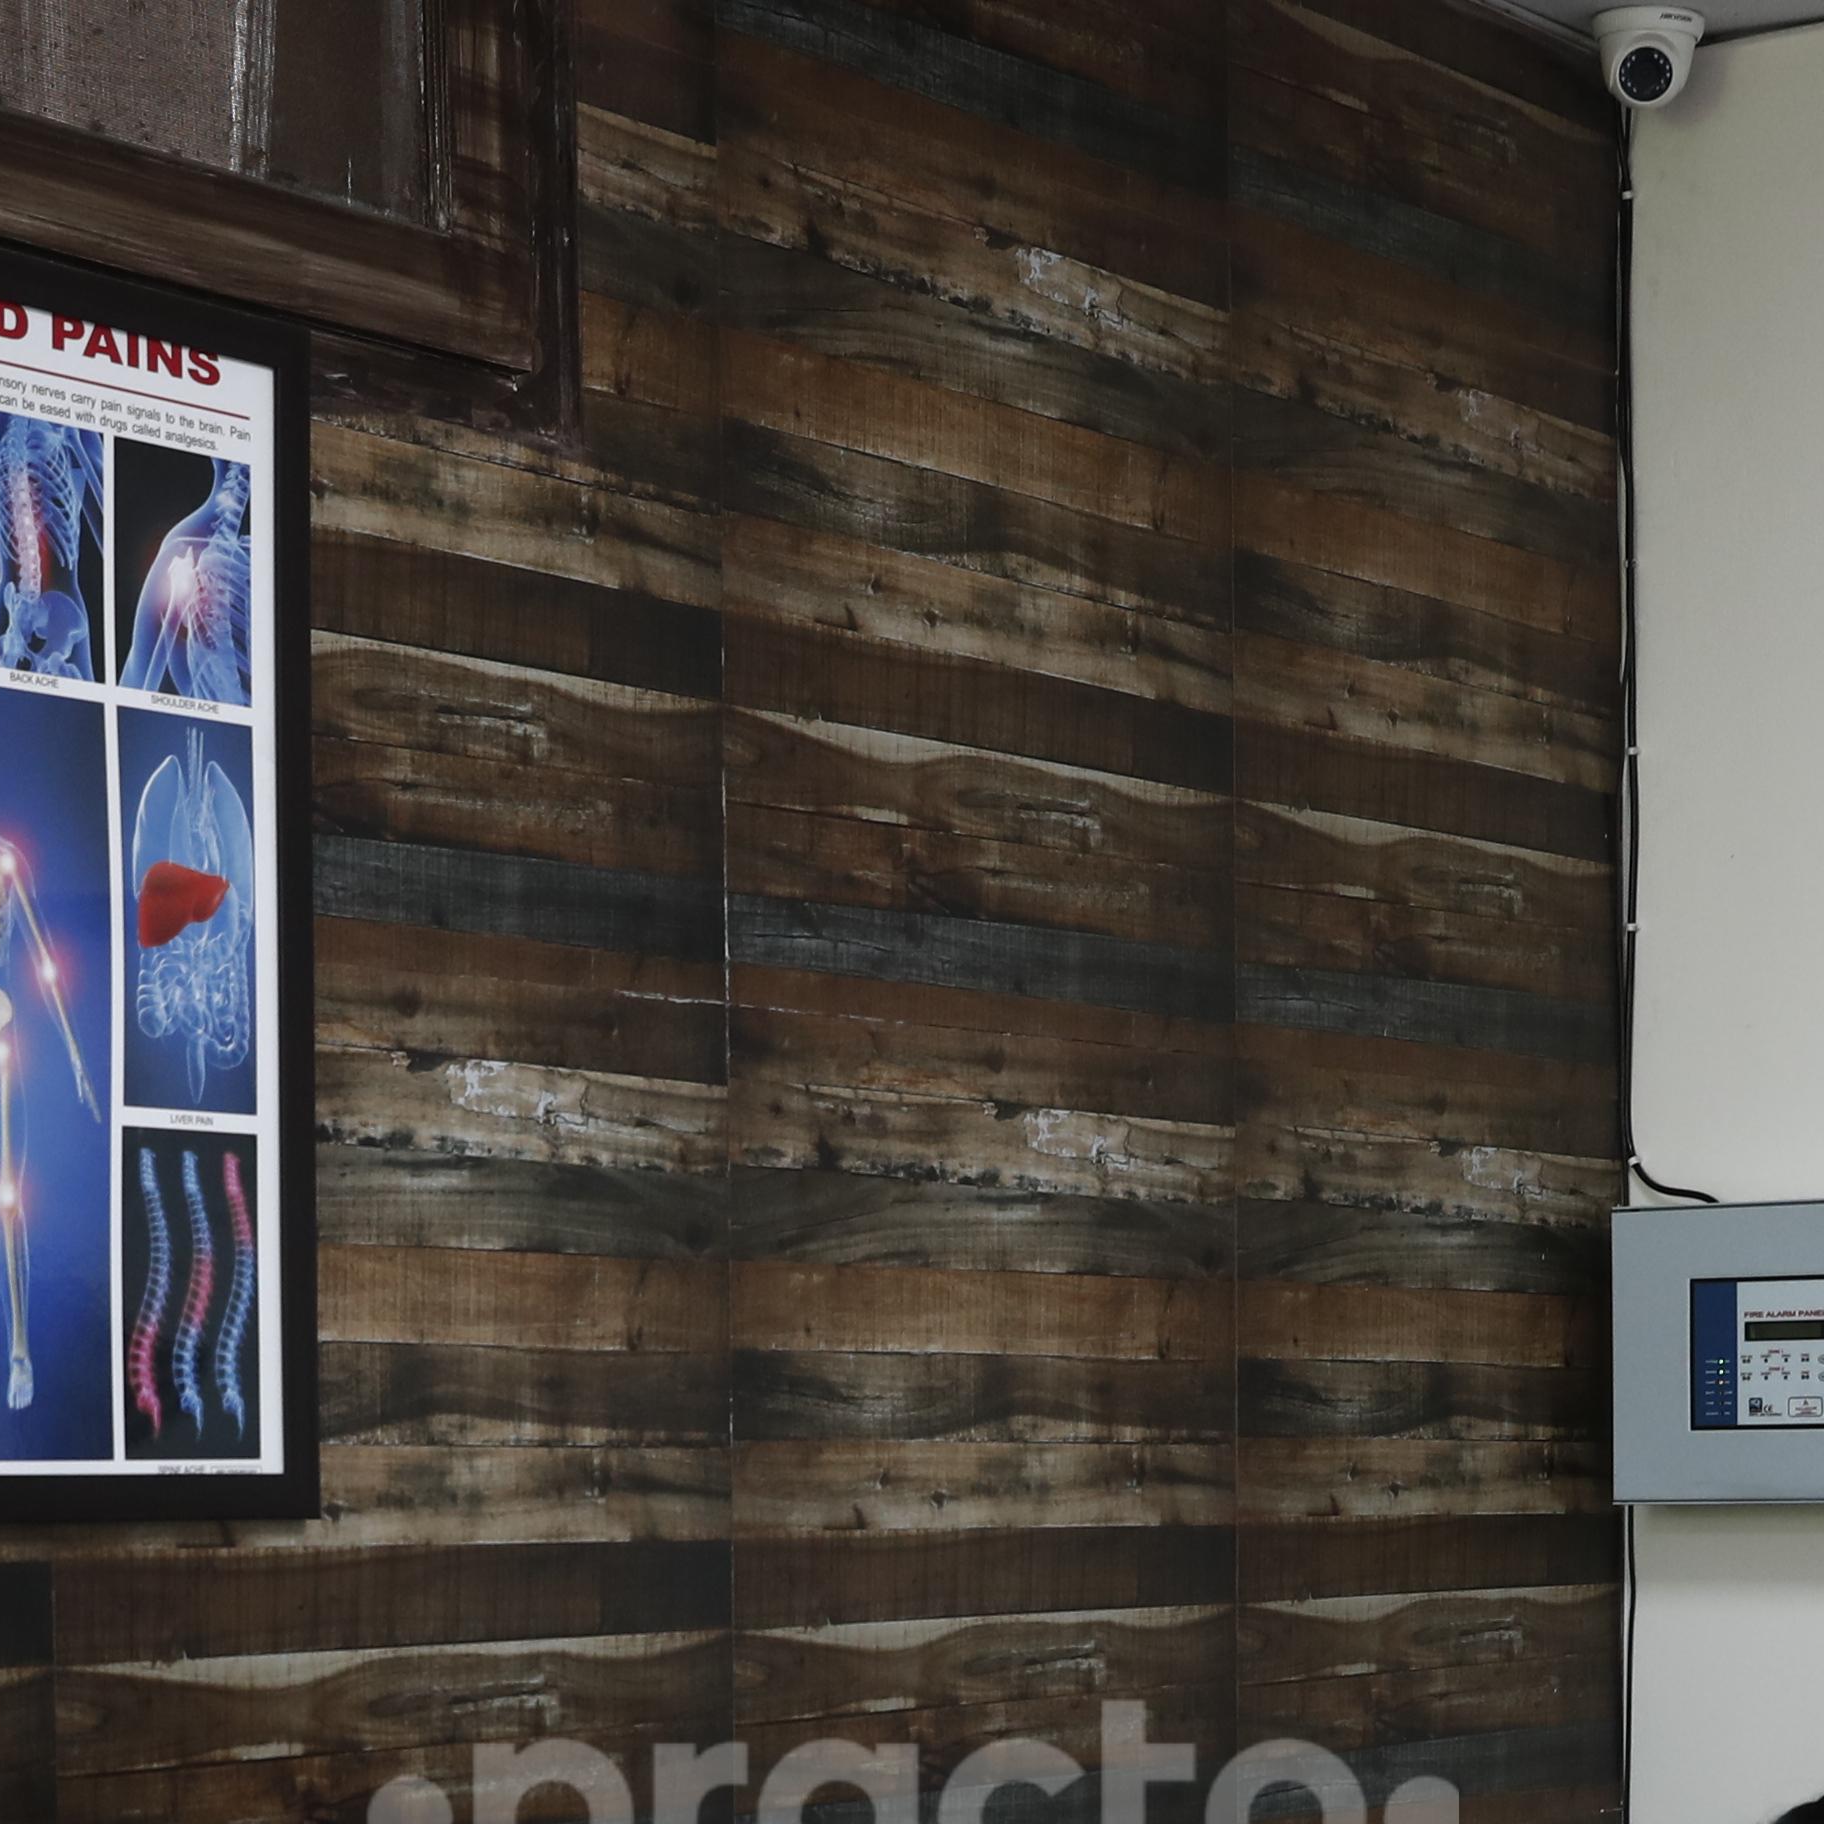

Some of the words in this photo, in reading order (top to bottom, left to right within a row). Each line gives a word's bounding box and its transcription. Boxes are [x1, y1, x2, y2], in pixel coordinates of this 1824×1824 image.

[52, 314, 221, 386] PAINS
[0, 394, 17, 407] can
[23, 396, 35, 411] be
[40, 402, 70, 418] eased
[76, 408, 96, 424] with
[100, 414, 127, 432] drugs
[132, 420, 160, 438] called
[32, 384, 66, 400] nerves
[72, 392, 96, 408] carry
[101, 396, 122, 414] pain
[128, 402, 160, 423] signals
[166, 410, 174, 424] to
[180, 412, 194, 428] the
[230, 424, 250, 441] Pain
[10, 672, 34, 684] BACK
[35, 676, 58, 688] ACHE
[151, 694, 196, 711] SHOULDER
[196, 702, 219, 714] ACHE
[170, 1113, 194, 1125] LIVER
[196, 1114, 214, 1126] PAIN
[1767, 1310, 1796, 1318] ALARM
